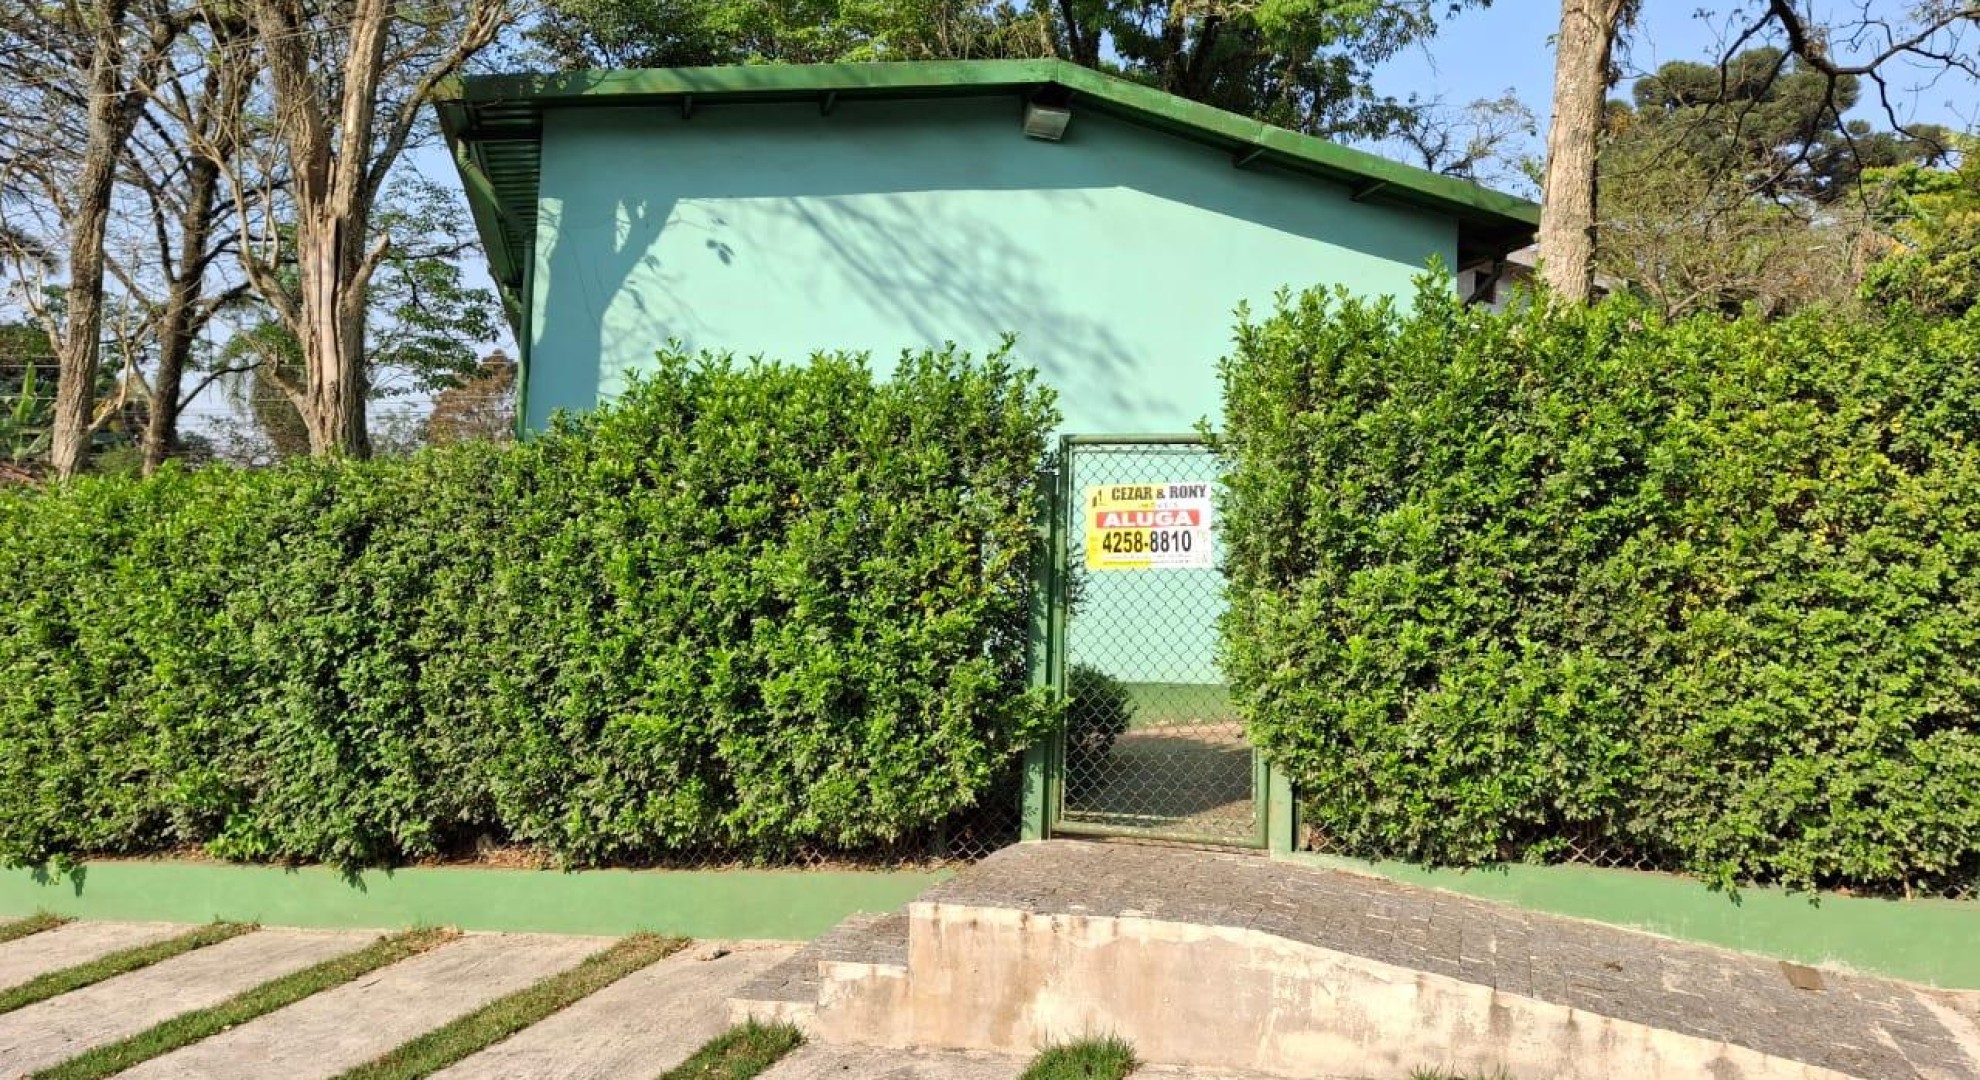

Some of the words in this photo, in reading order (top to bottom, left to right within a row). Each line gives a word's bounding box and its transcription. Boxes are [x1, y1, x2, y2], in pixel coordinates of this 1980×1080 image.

[1111, 487, 1152, 501] CEZAR
[1156, 489, 1165, 499] &
[1169, 485, 1207, 499] RONY
[1103, 510, 1193, 527] ALUGA
[1102, 530, 1192, 553] 4258-8810
